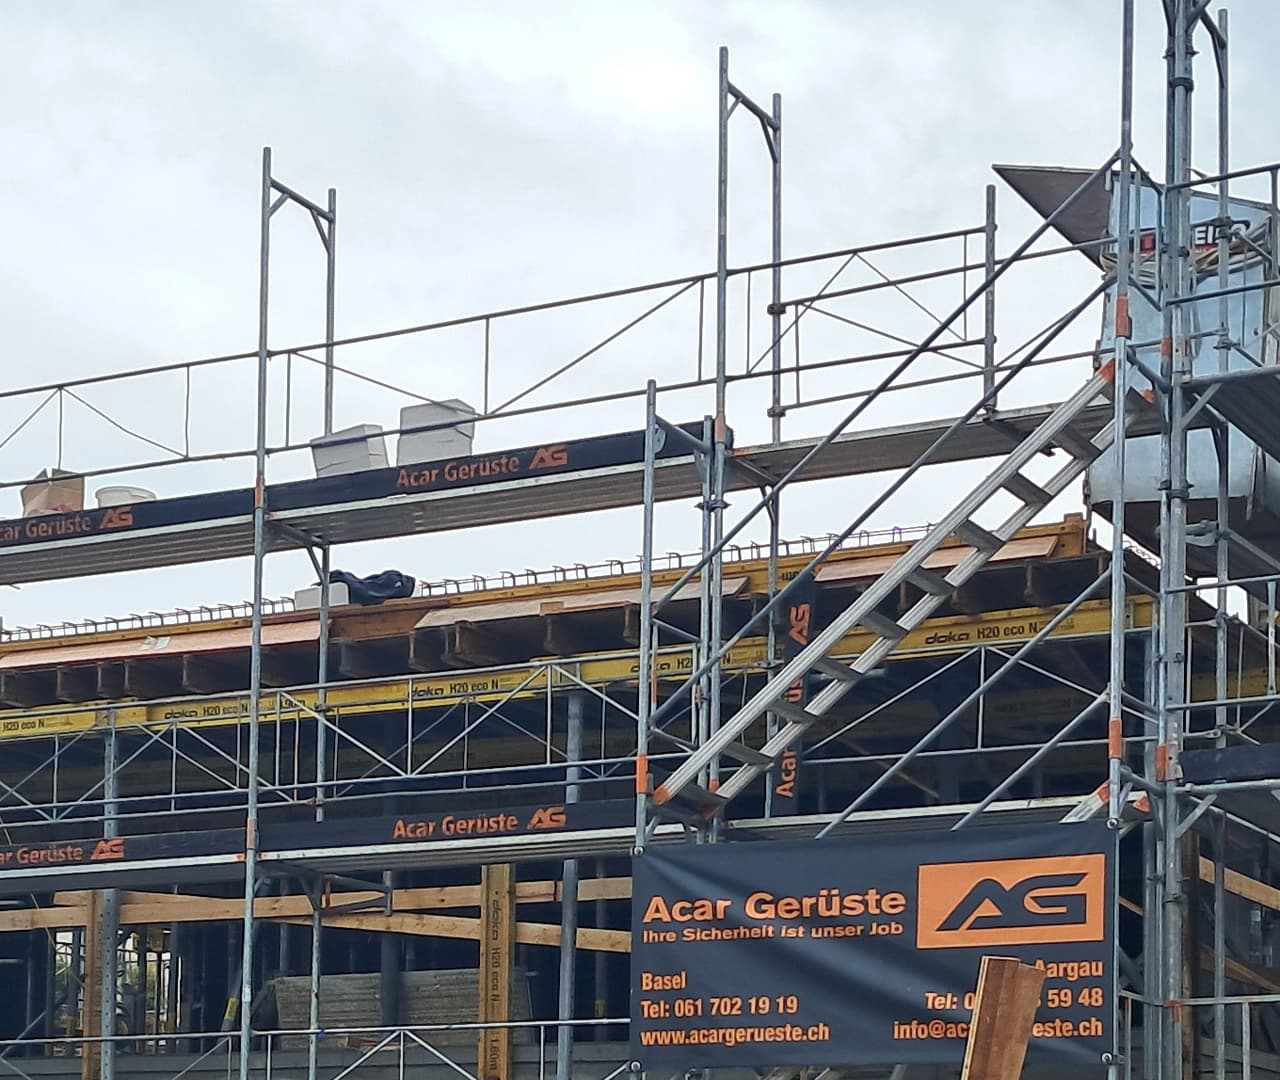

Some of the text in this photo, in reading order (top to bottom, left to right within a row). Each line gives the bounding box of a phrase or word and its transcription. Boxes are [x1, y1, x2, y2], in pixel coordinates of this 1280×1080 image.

[397, 444, 568, 488] Acar Gerüste AG
[99, 506, 132, 528] AG
[925, 623, 1037, 645] doka H20 eco N
[450, 683, 468, 694] H20
[471, 682, 488, 691] eco
[203, 706, 220, 715] H20
[393, 806, 566, 839] Acar Gerüste AG
[17, 845, 82, 864] Gerüste
[90, 839, 124, 860] AG
[642, 887, 907, 923] Acar Gerüste
[935, 872, 1089, 931] AG
[492, 901, 502, 941] doka
[642, 921, 903, 943] Ihre Sicherheit ist unser Job
[642, 972, 687, 991] Basel
[642, 996, 798, 1019] Tel: 061 702 19 19
[925, 992, 957, 1010] Tel:
[1048, 987, 1103, 1007] 59 48
[640, 1023, 830, 1047] www.acargerueste.ch
